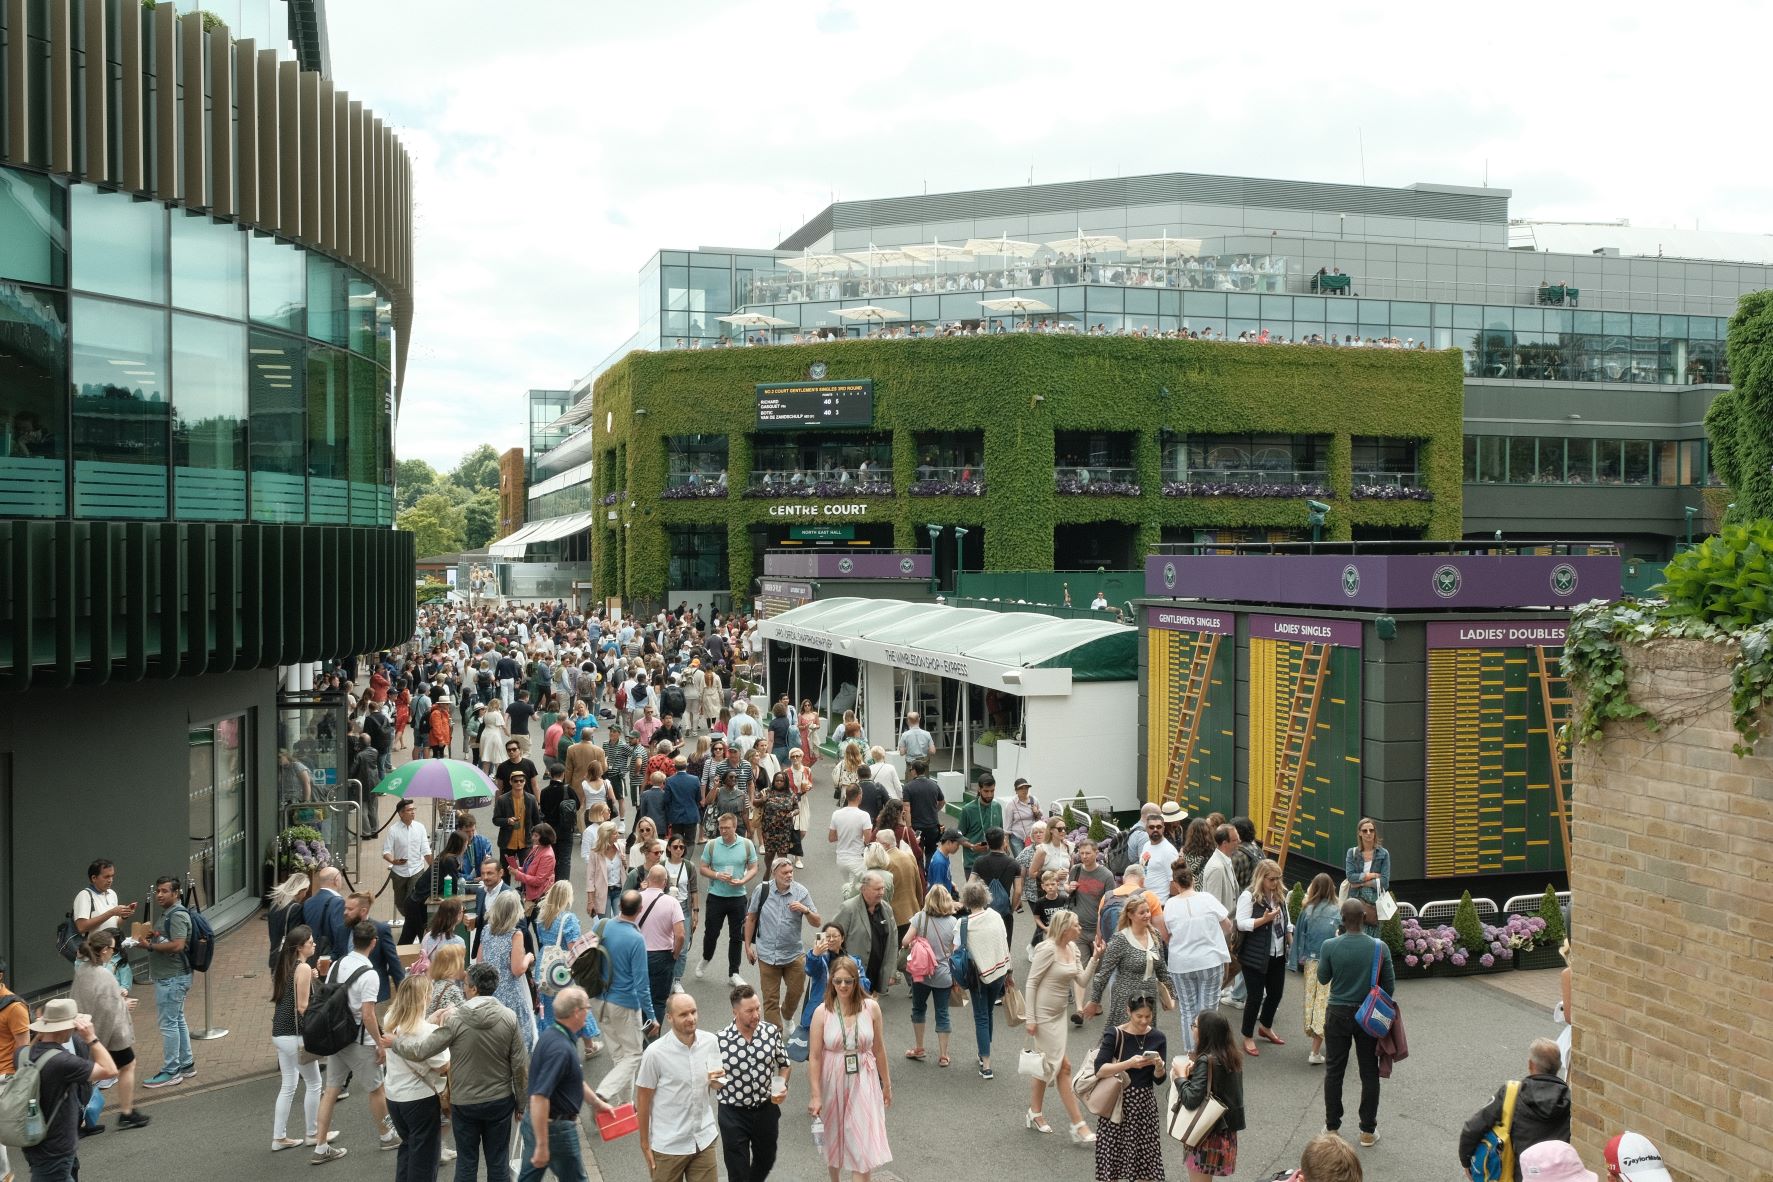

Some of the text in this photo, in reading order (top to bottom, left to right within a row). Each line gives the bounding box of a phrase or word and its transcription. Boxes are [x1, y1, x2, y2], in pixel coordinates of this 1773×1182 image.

[769, 504, 868, 516] CENTRE COURT
[1159, 614, 1220, 628] GENTLEMEN'S SINGLES
[1274, 623, 1331, 637] LADIES' SINGLES
[1460, 629, 1565, 640] LADIES' DOUBLES
[885, 649, 896, 662] THE
[896, 652, 925, 667] WIMBLEDON
[925, 656, 940, 670] SHOP
[944, 660, 968, 677] EXPRESS
